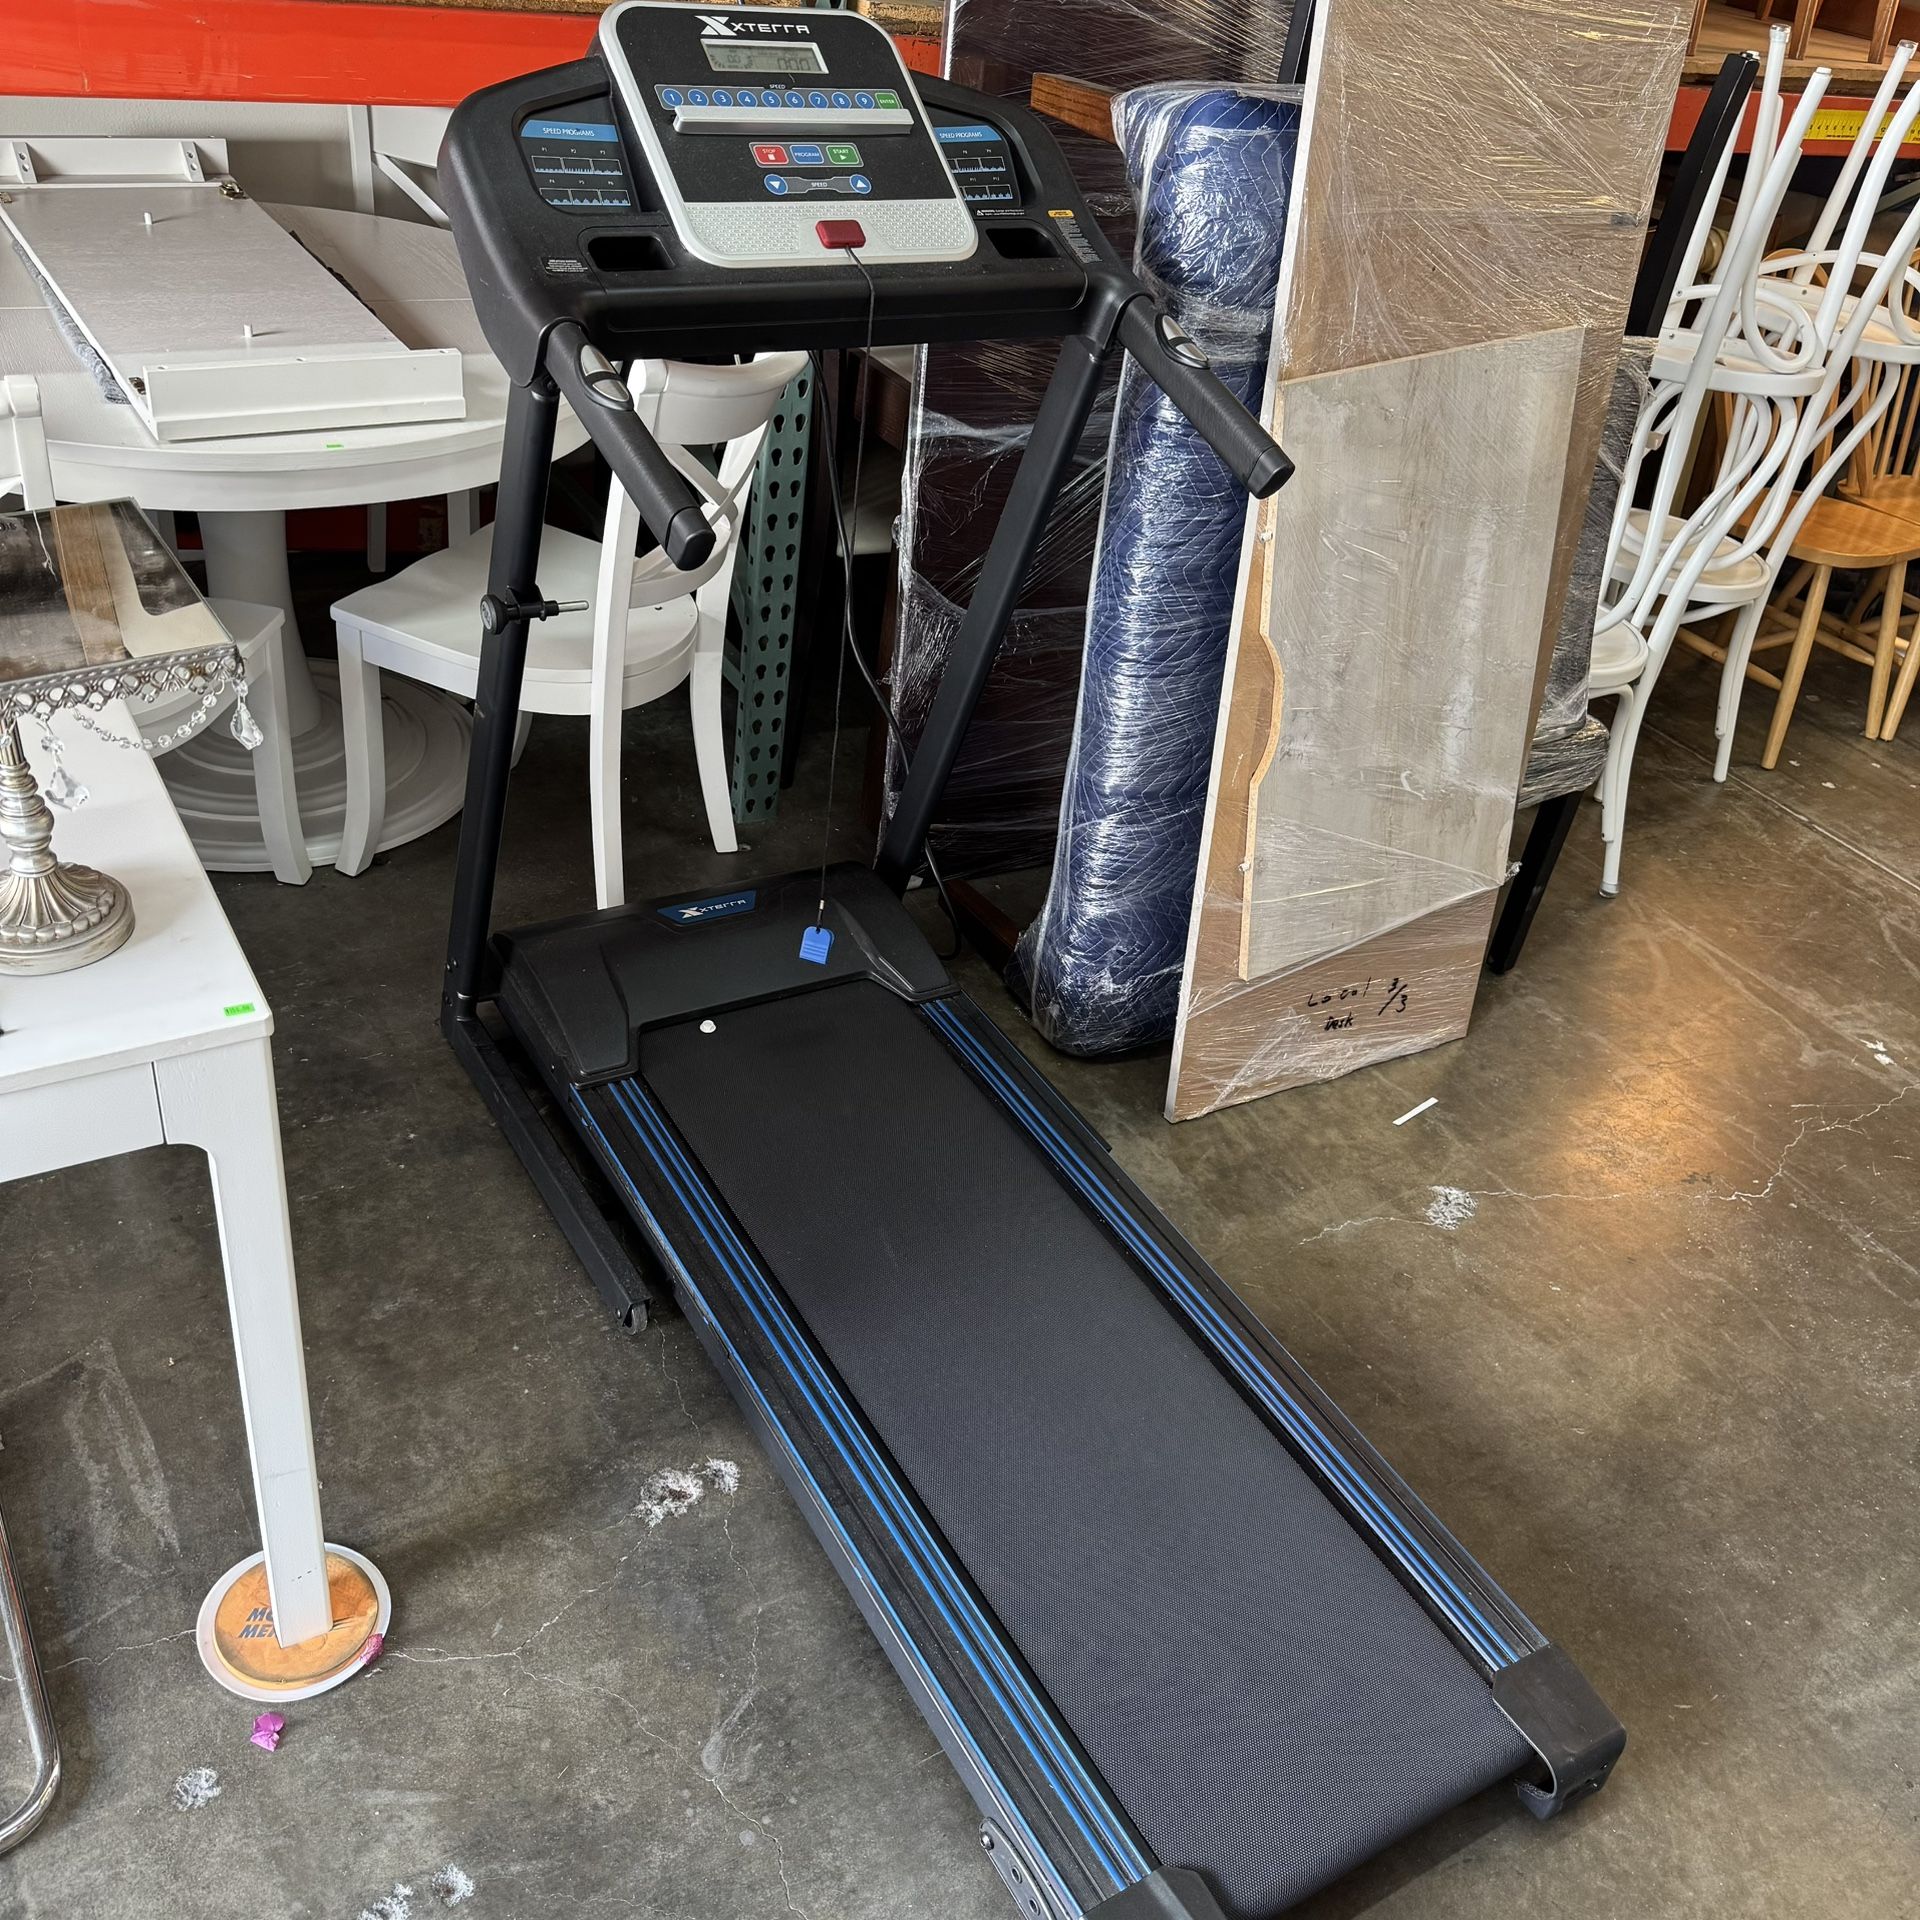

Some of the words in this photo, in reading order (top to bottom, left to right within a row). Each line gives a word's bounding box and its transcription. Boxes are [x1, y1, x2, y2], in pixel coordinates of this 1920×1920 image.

[730, 22, 810, 34] XTERRA
[669, 93, 675, 101] 1
[695, 94, 702, 102] 2
[719, 95, 726, 103] 3
[768, 96, 775, 104] 5
[791, 96, 798, 104] 6
[814, 96, 821, 105] 7
[839, 97, 846, 105] 8
[861, 97, 868, 105] 9
[542, 127, 561, 135] SPEED
[562, 128, 595, 137] PROGRAMS
[699, 899, 747, 913] XTERRA
